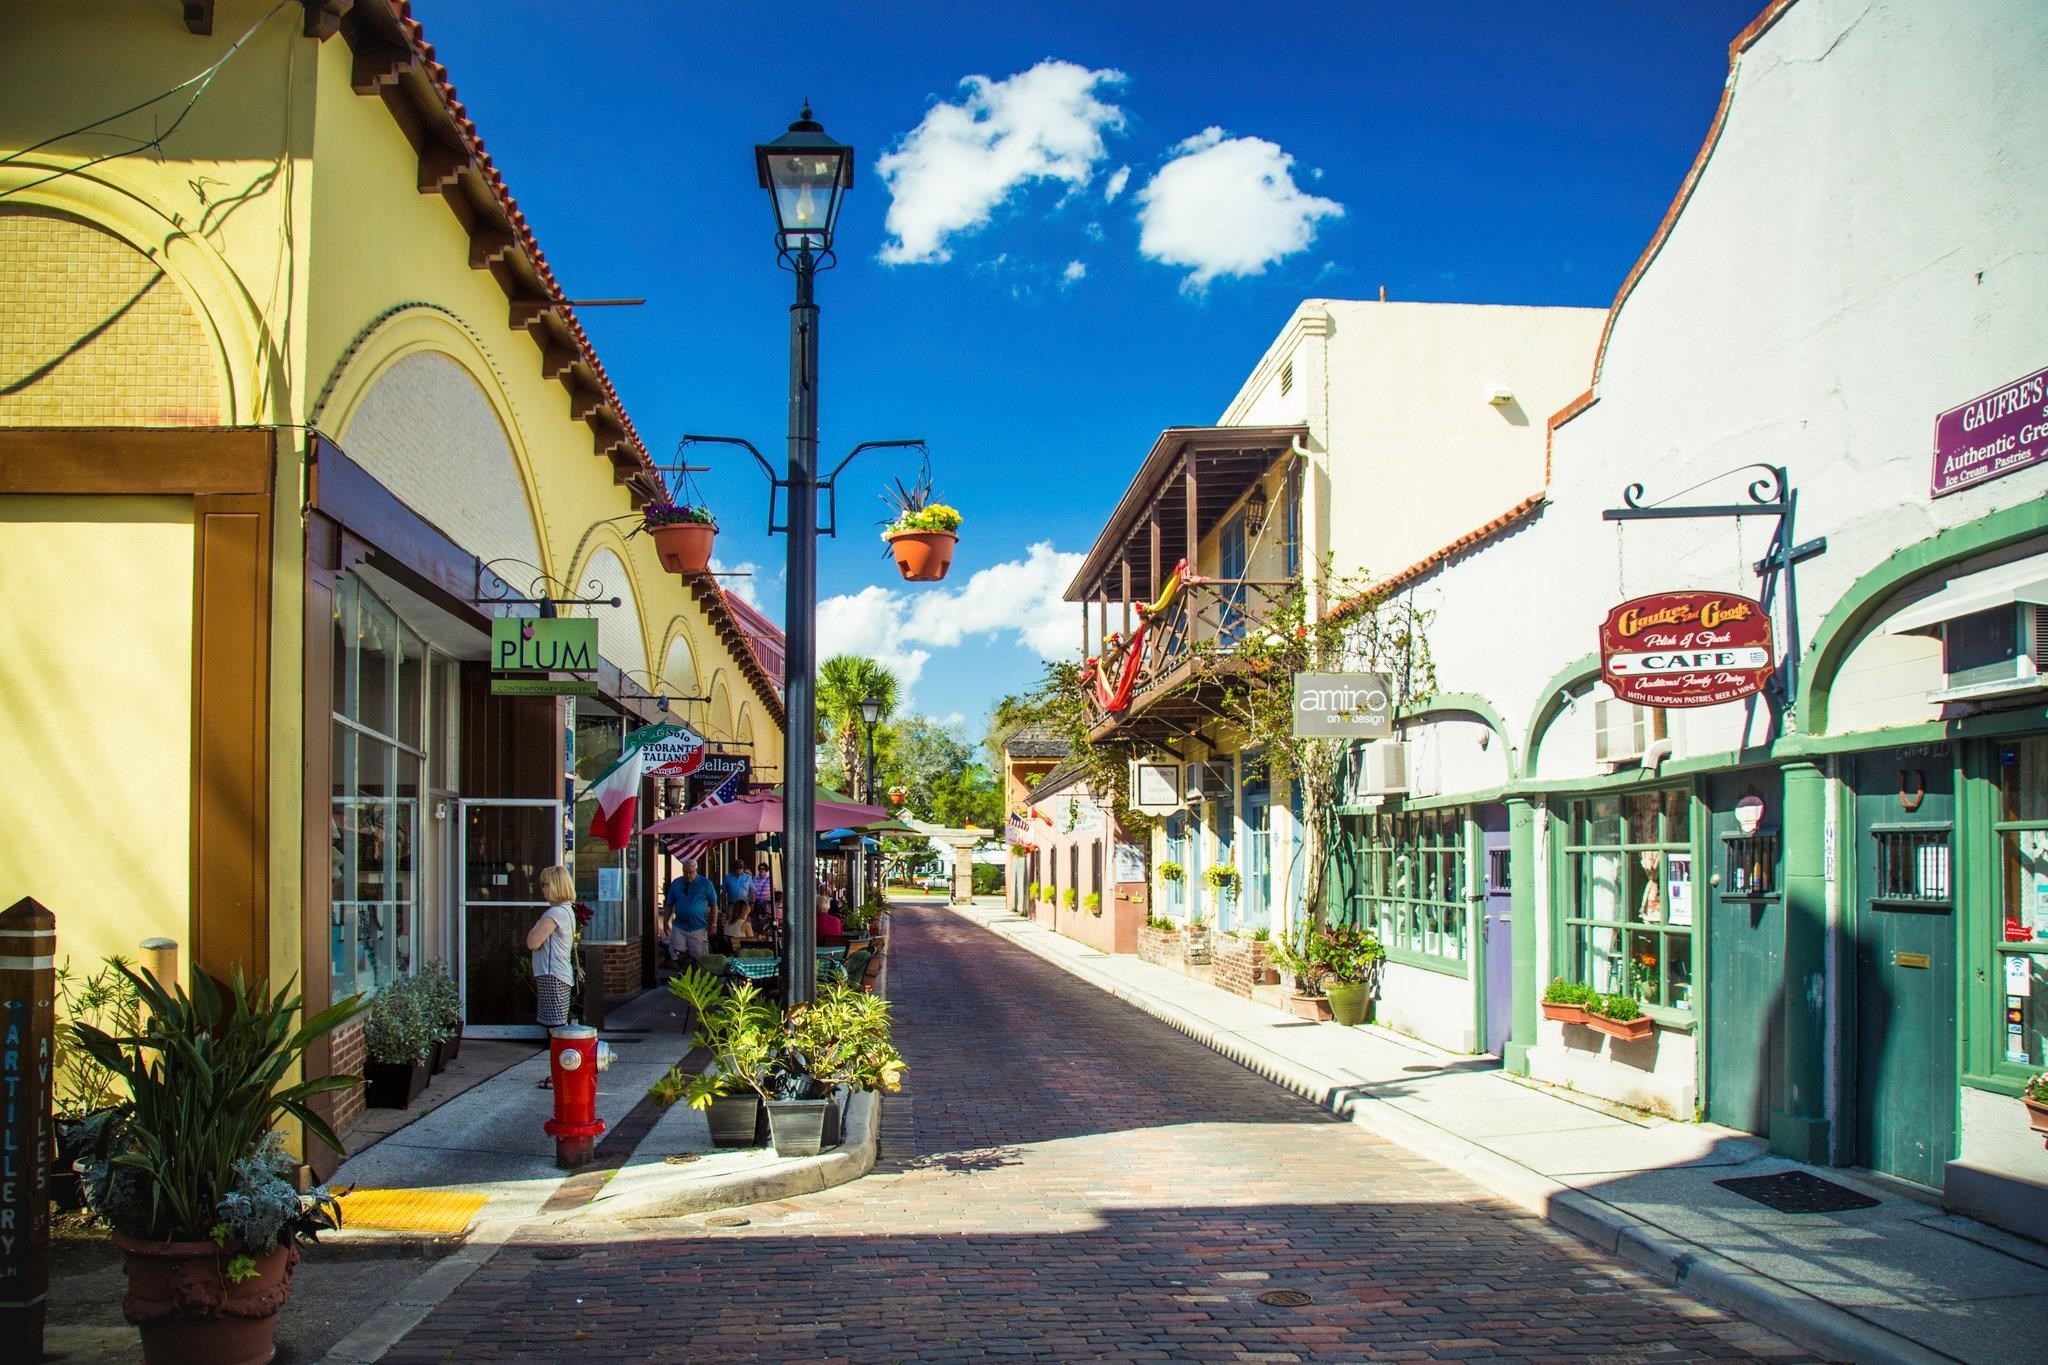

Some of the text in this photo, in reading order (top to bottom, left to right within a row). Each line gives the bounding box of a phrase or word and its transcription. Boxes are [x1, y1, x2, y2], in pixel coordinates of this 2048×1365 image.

[1943, 434, 2016, 475] Authentic
[1944, 475, 1959, 487] Ice
[1959, 465, 1988, 481] Cream
[1994, 448, 2032, 470] Pastries
[1700, 600, 1752, 629] Goods
[501, 618, 591, 670] PLUM
[1643, 631, 1731, 648] Polish & Greek
[1641, 652, 1736, 670] CAFE
[497, 684, 591, 693] CONTEMPORARY GALLERY
[1634, 672, 1746, 690] Traditional Family Dining
[1299, 684, 1388, 712] amiro
[1627, 690, 1646, 701] WITH
[1647, 694, 1683, 704] EUROPEAN
[1715, 690, 1732, 701] BEER
[1732, 689, 1738, 697] &
[1737, 682, 1757, 694] WINE
[667, 728, 691, 742] Solo
[642, 743, 698, 753] STORANTE
[643, 753, 689, 762] TALIANO
[37, 1036, 49, 1190] AVILES
[1, 1023, 20, 1256] ARTILLERY
